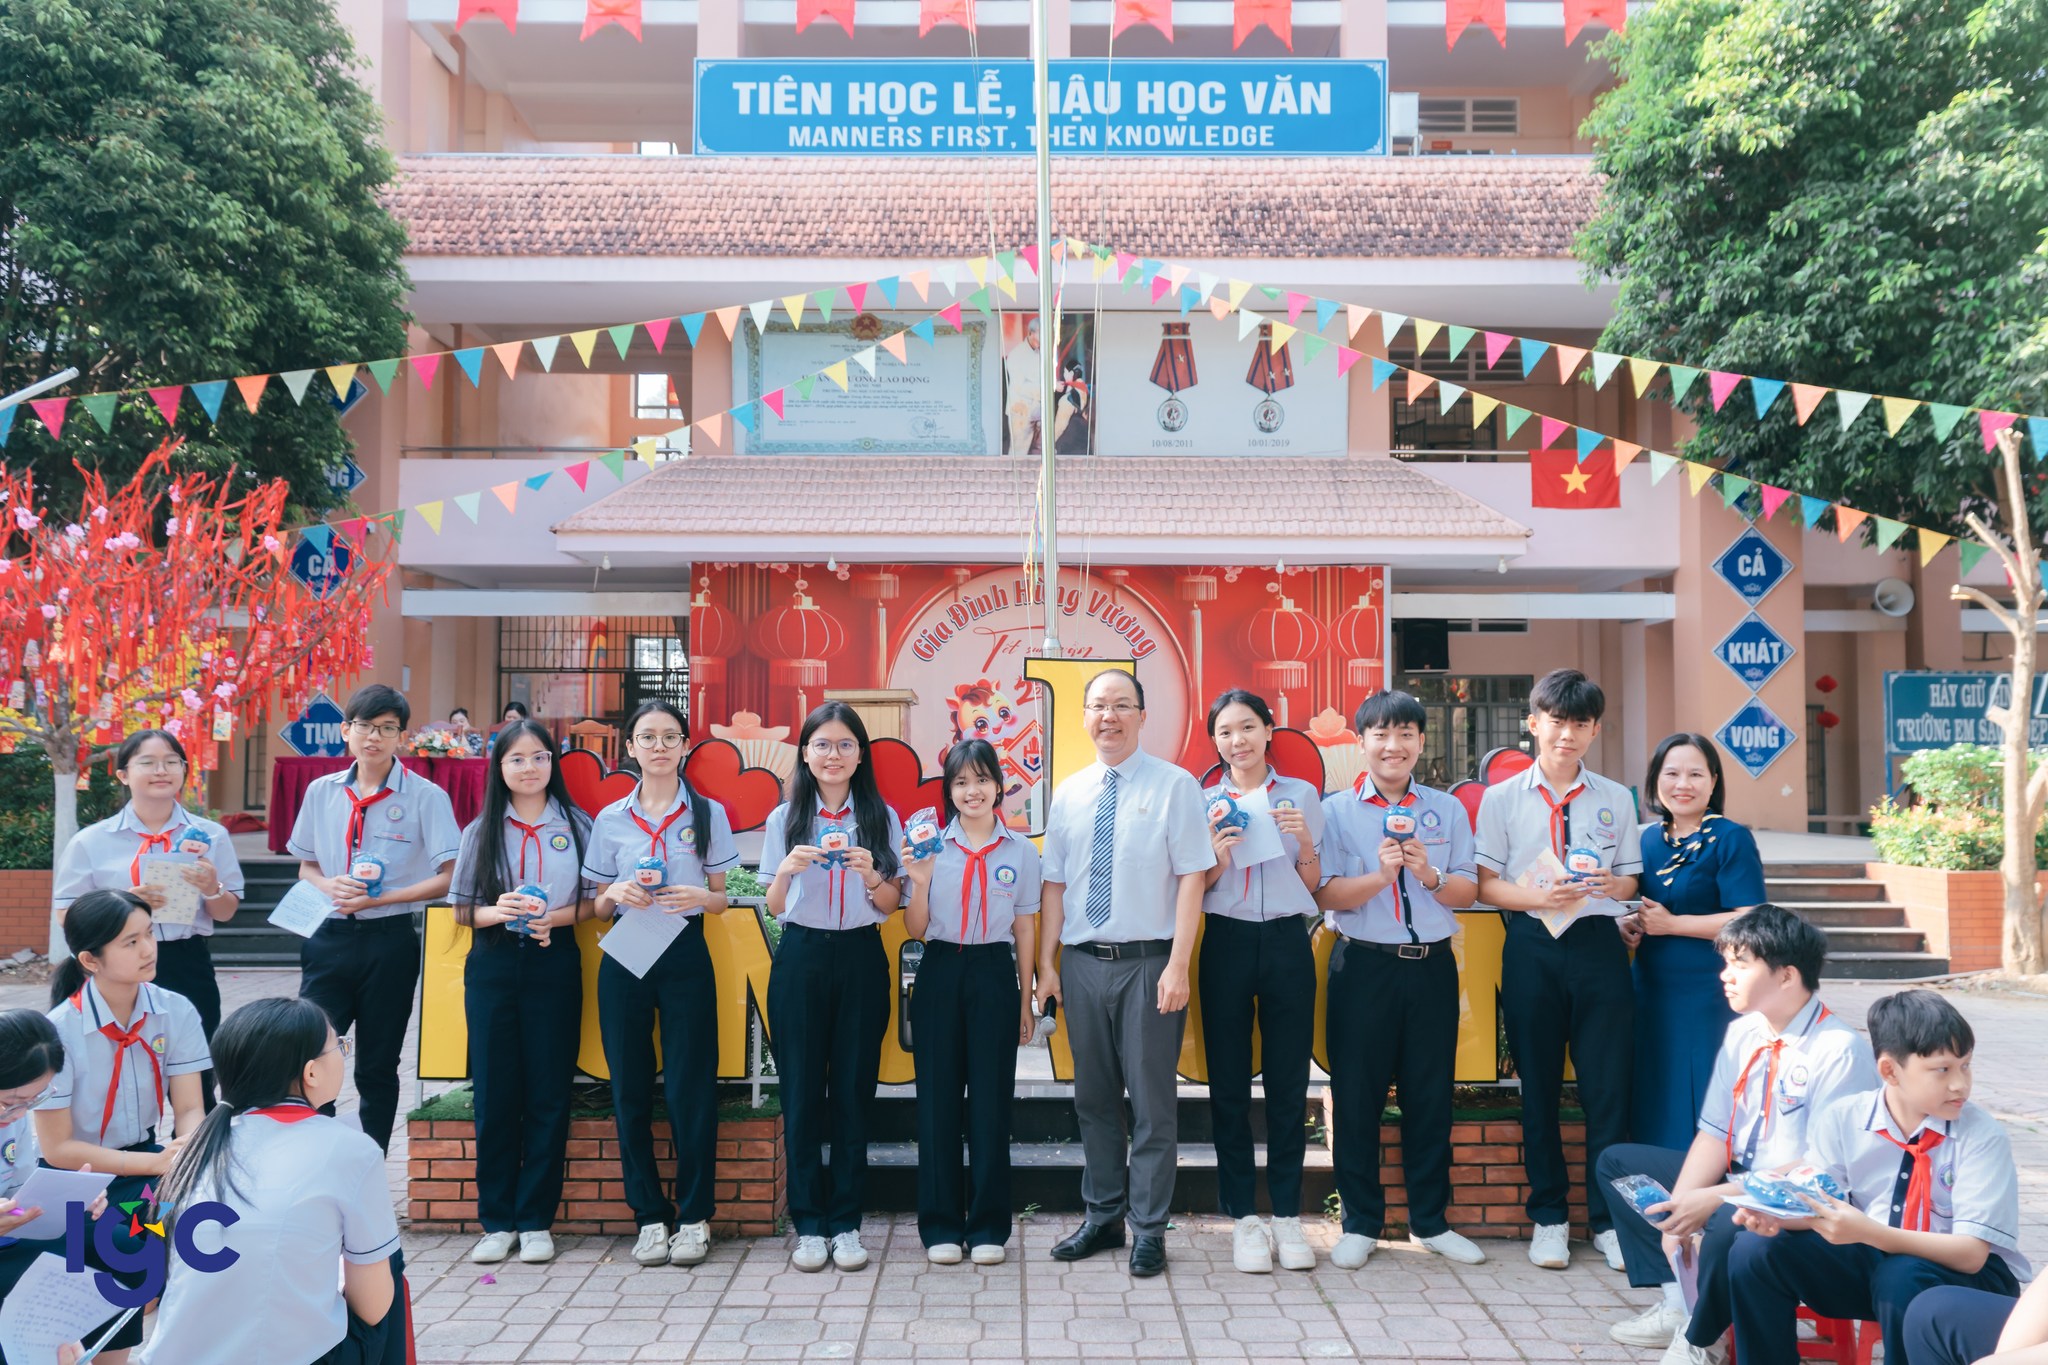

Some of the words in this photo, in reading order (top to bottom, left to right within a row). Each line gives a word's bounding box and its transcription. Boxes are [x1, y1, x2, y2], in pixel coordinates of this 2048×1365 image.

[732, 74, 832, 115] TIÊN
[848, 80, 937, 122] HỌC
[953, 68, 1016, 119] LỄ,
[1137, 80, 1228, 122] HỌC
[1241, 74, 1331, 115] VĂN
[788, 125, 923, 147] MANNERS
[932, 125, 1017, 149] FIRST,
[1106, 125, 1275, 146] KNOWLEDGE
[1152, 439, 1193, 448] 10/08/2011
[1248, 439, 1290, 448] 10/01/2019
[1737, 548, 1767, 577] CẢ
[912, 620, 953, 661] Gia
[947, 584, 1009, 630] Đình
[1087, 589, 1157, 660] Vương
[1728, 638, 1782, 665] KHÁT
[303, 722, 342, 745] TIM
[1731, 725, 1780, 752] VỌNG
[1954, 718, 1976, 742] EM
